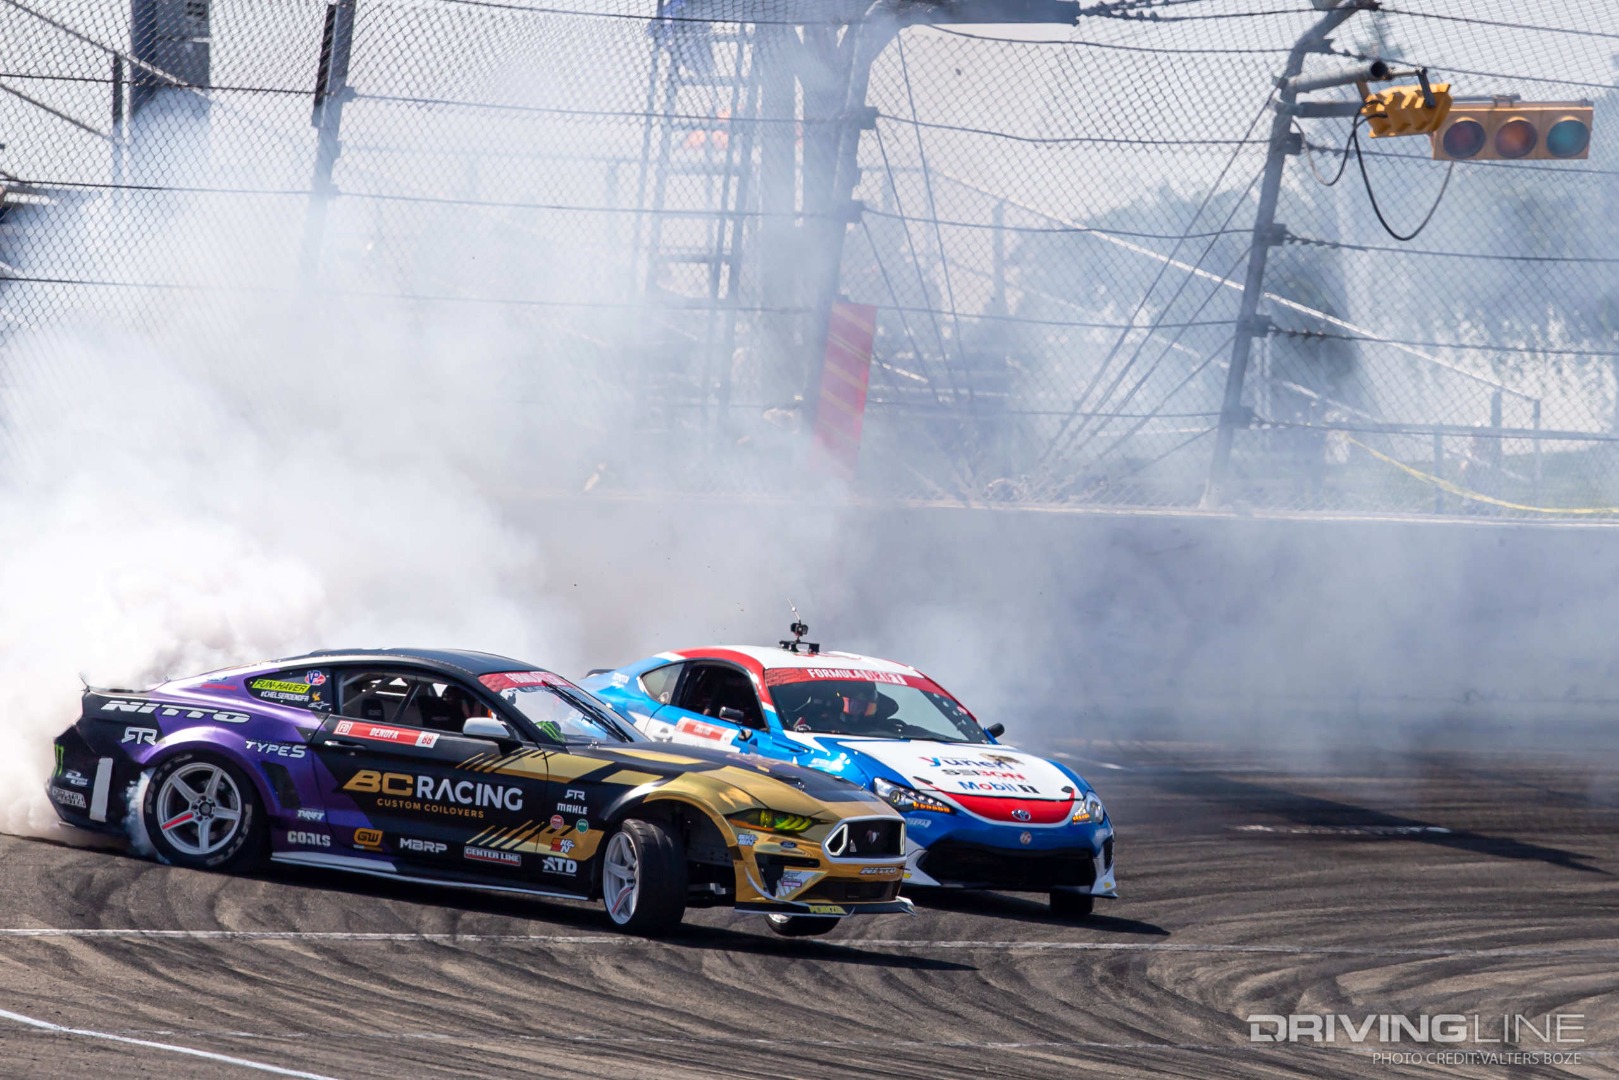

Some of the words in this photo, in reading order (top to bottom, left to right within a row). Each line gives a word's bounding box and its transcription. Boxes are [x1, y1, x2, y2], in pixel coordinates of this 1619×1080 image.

[807, 668, 864, 680] FORMULA
[255, 680, 308, 692] FUN-HAVER
[101, 700, 250, 724] NITTO
[958, 781, 1018, 792] Mobil
[376, 798, 421, 811] CUSTOM
[424, 803, 485, 819] COILOVERS
[556, 802, 588, 815] MAHLE
[399, 837, 448, 854] MBRP
[465, 848, 500, 859] CENTER
[500, 852, 520, 863] LINE
